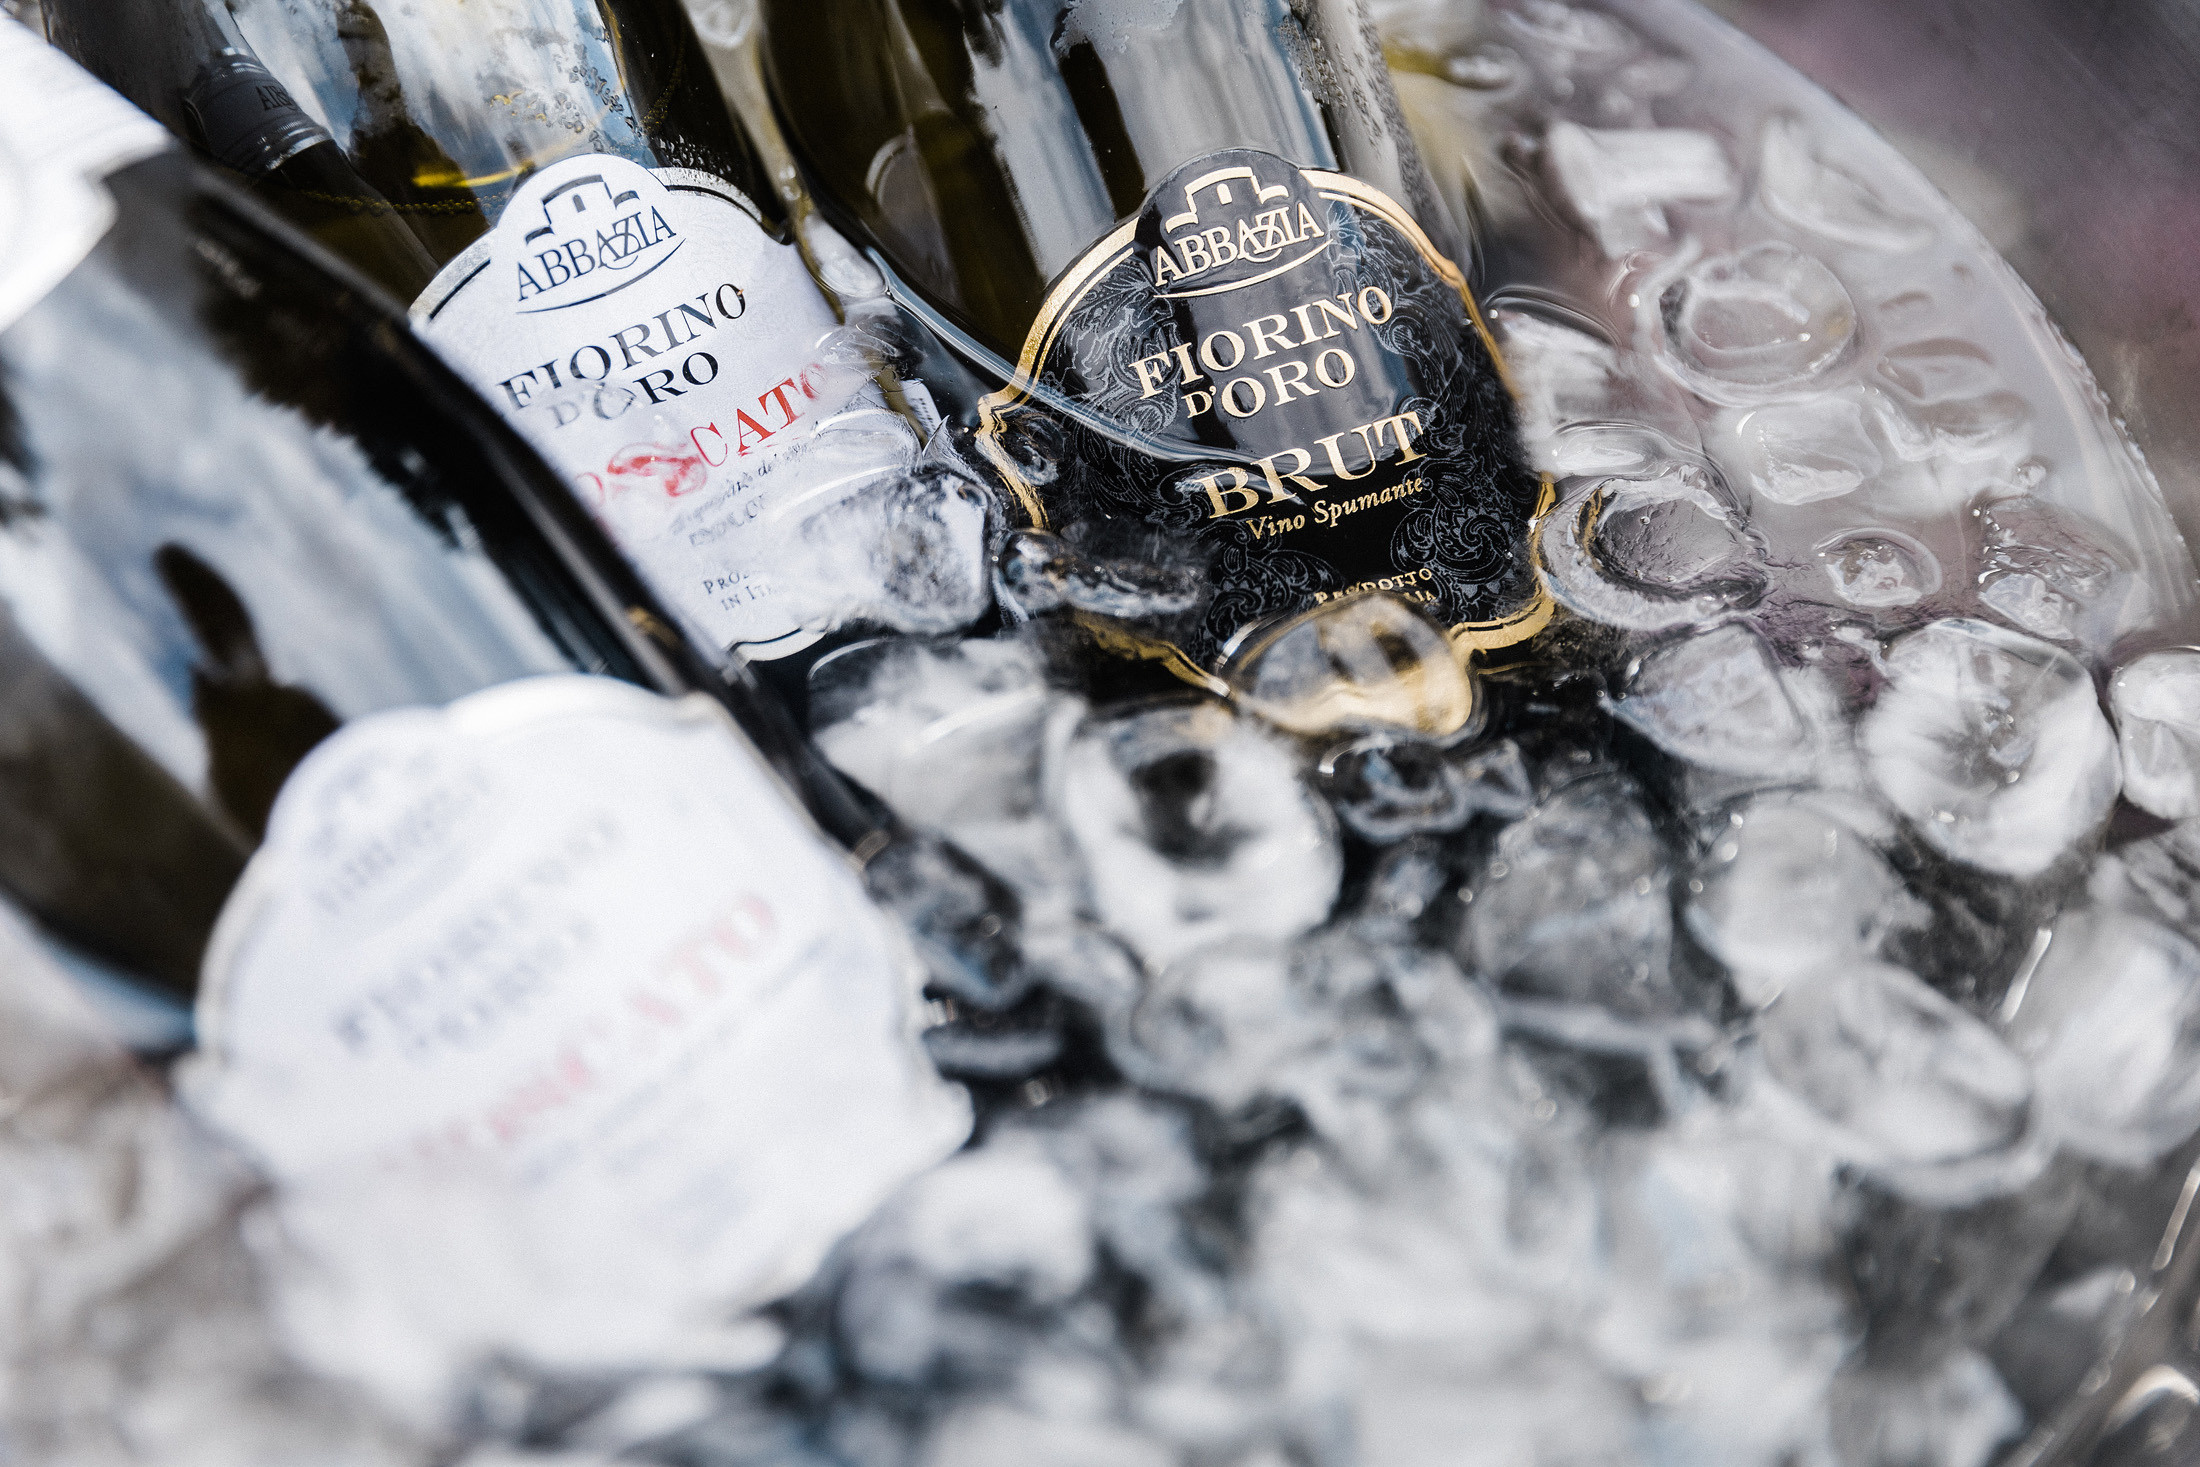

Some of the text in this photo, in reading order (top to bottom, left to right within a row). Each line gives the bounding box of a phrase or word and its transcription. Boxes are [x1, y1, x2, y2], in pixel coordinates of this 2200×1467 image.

[516, 205, 677, 301] ABBAZIA
[1154, 203, 1324, 287] ABBAZIA
[496, 283, 746, 411] FIORINO
[1128, 286, 1393, 400] FIORINO
[1182, 348, 1356, 419] D'ORO
[1194, 411, 1428, 519] BRUT
[1246, 477, 1425, 540] Vino Spumante
